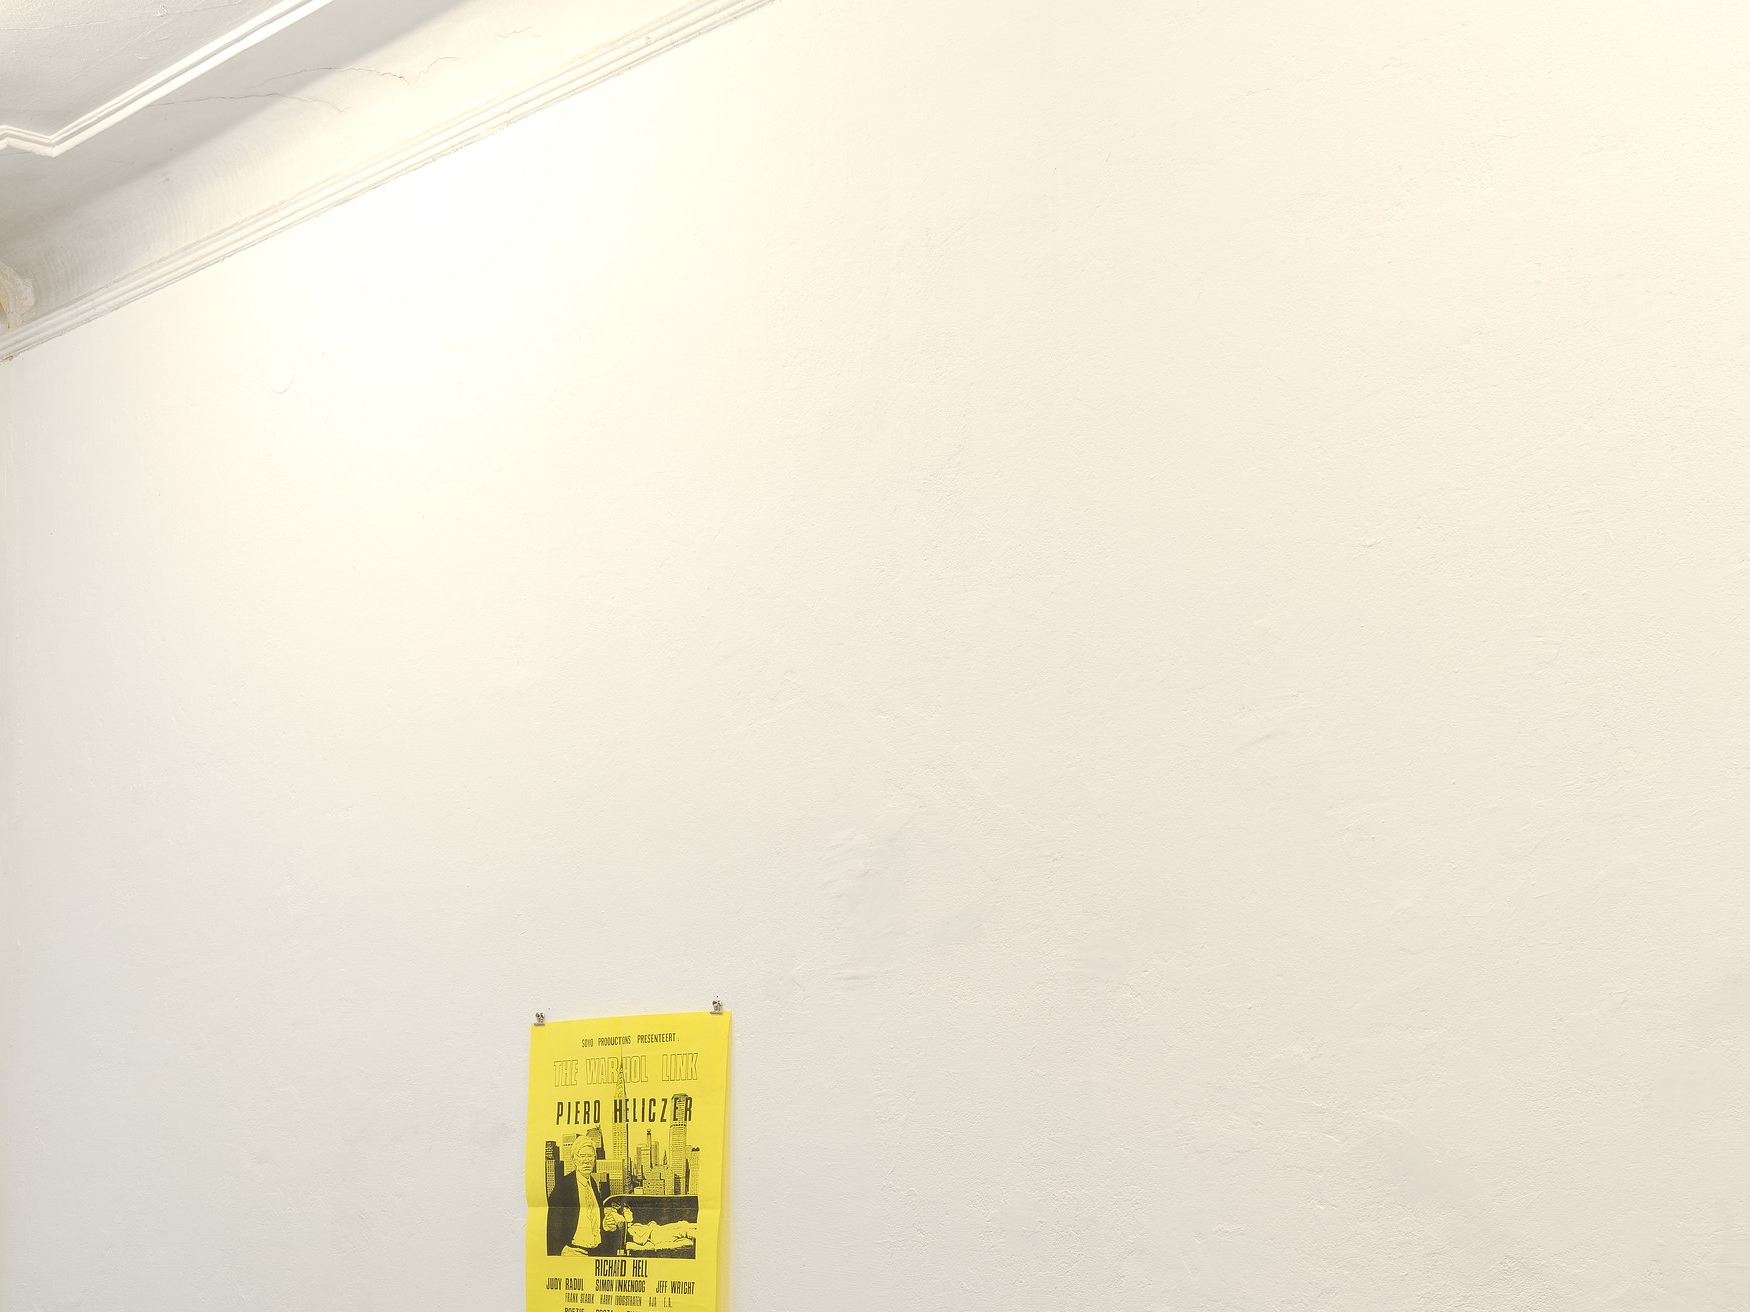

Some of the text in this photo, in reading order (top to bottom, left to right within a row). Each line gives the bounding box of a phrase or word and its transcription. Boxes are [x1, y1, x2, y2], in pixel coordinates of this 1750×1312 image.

[554, 1053, 698, 1087] THE WARHOL LINK
[556, 1097, 693, 1125] PIERO HELICZER
[595, 1260, 648, 1278] RICHARD HELL
[546, 1277, 562, 1291] JUDY
[595, 1280, 613, 1292] SIMON
[656, 1280, 668, 1294] JEFF
[670, 1281, 696, 1295] WRIGHT
